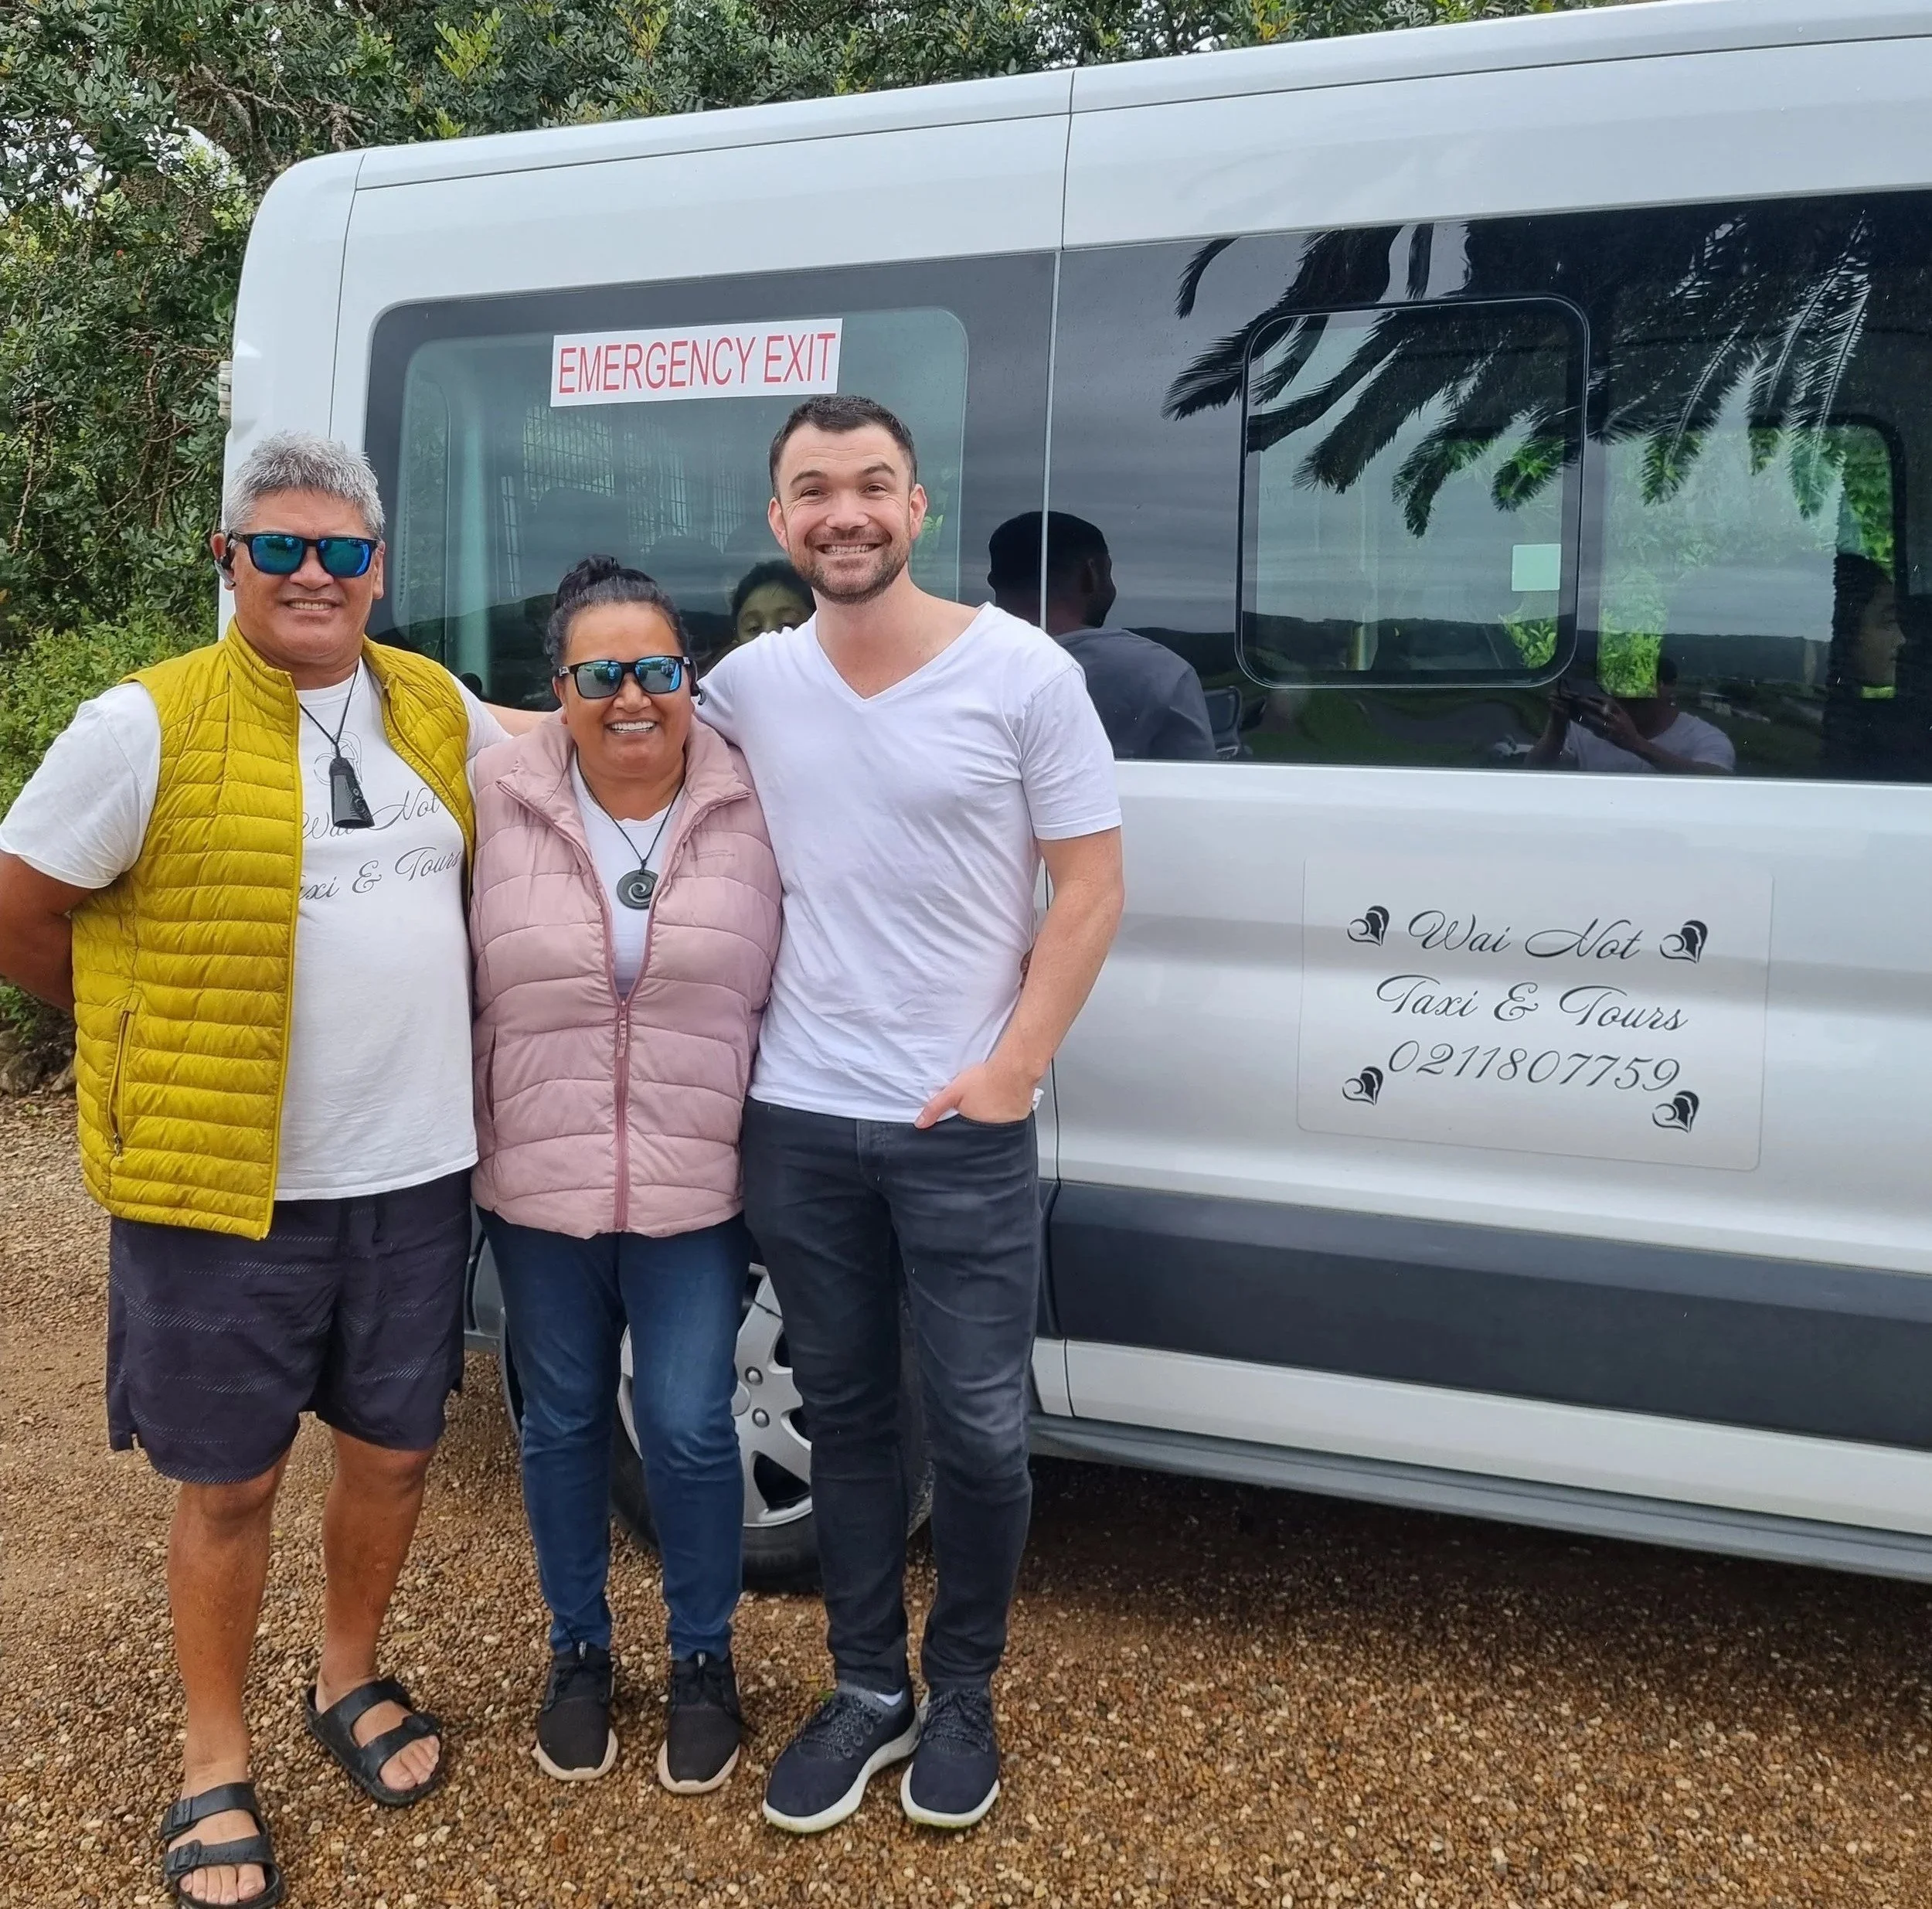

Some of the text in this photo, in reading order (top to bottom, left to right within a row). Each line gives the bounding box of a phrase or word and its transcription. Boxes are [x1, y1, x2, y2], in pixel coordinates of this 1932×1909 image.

[559, 332, 836, 393] EMERGENCY EXIT
[368, 787, 440, 831] Not
[298, 846, 461, 900] xi & Tours
[1408, 910, 1645, 960] Wai Not
[1376, 974, 1689, 1031] Taxi & Tours
[1388, 1040, 1681, 1092] 0211807759
